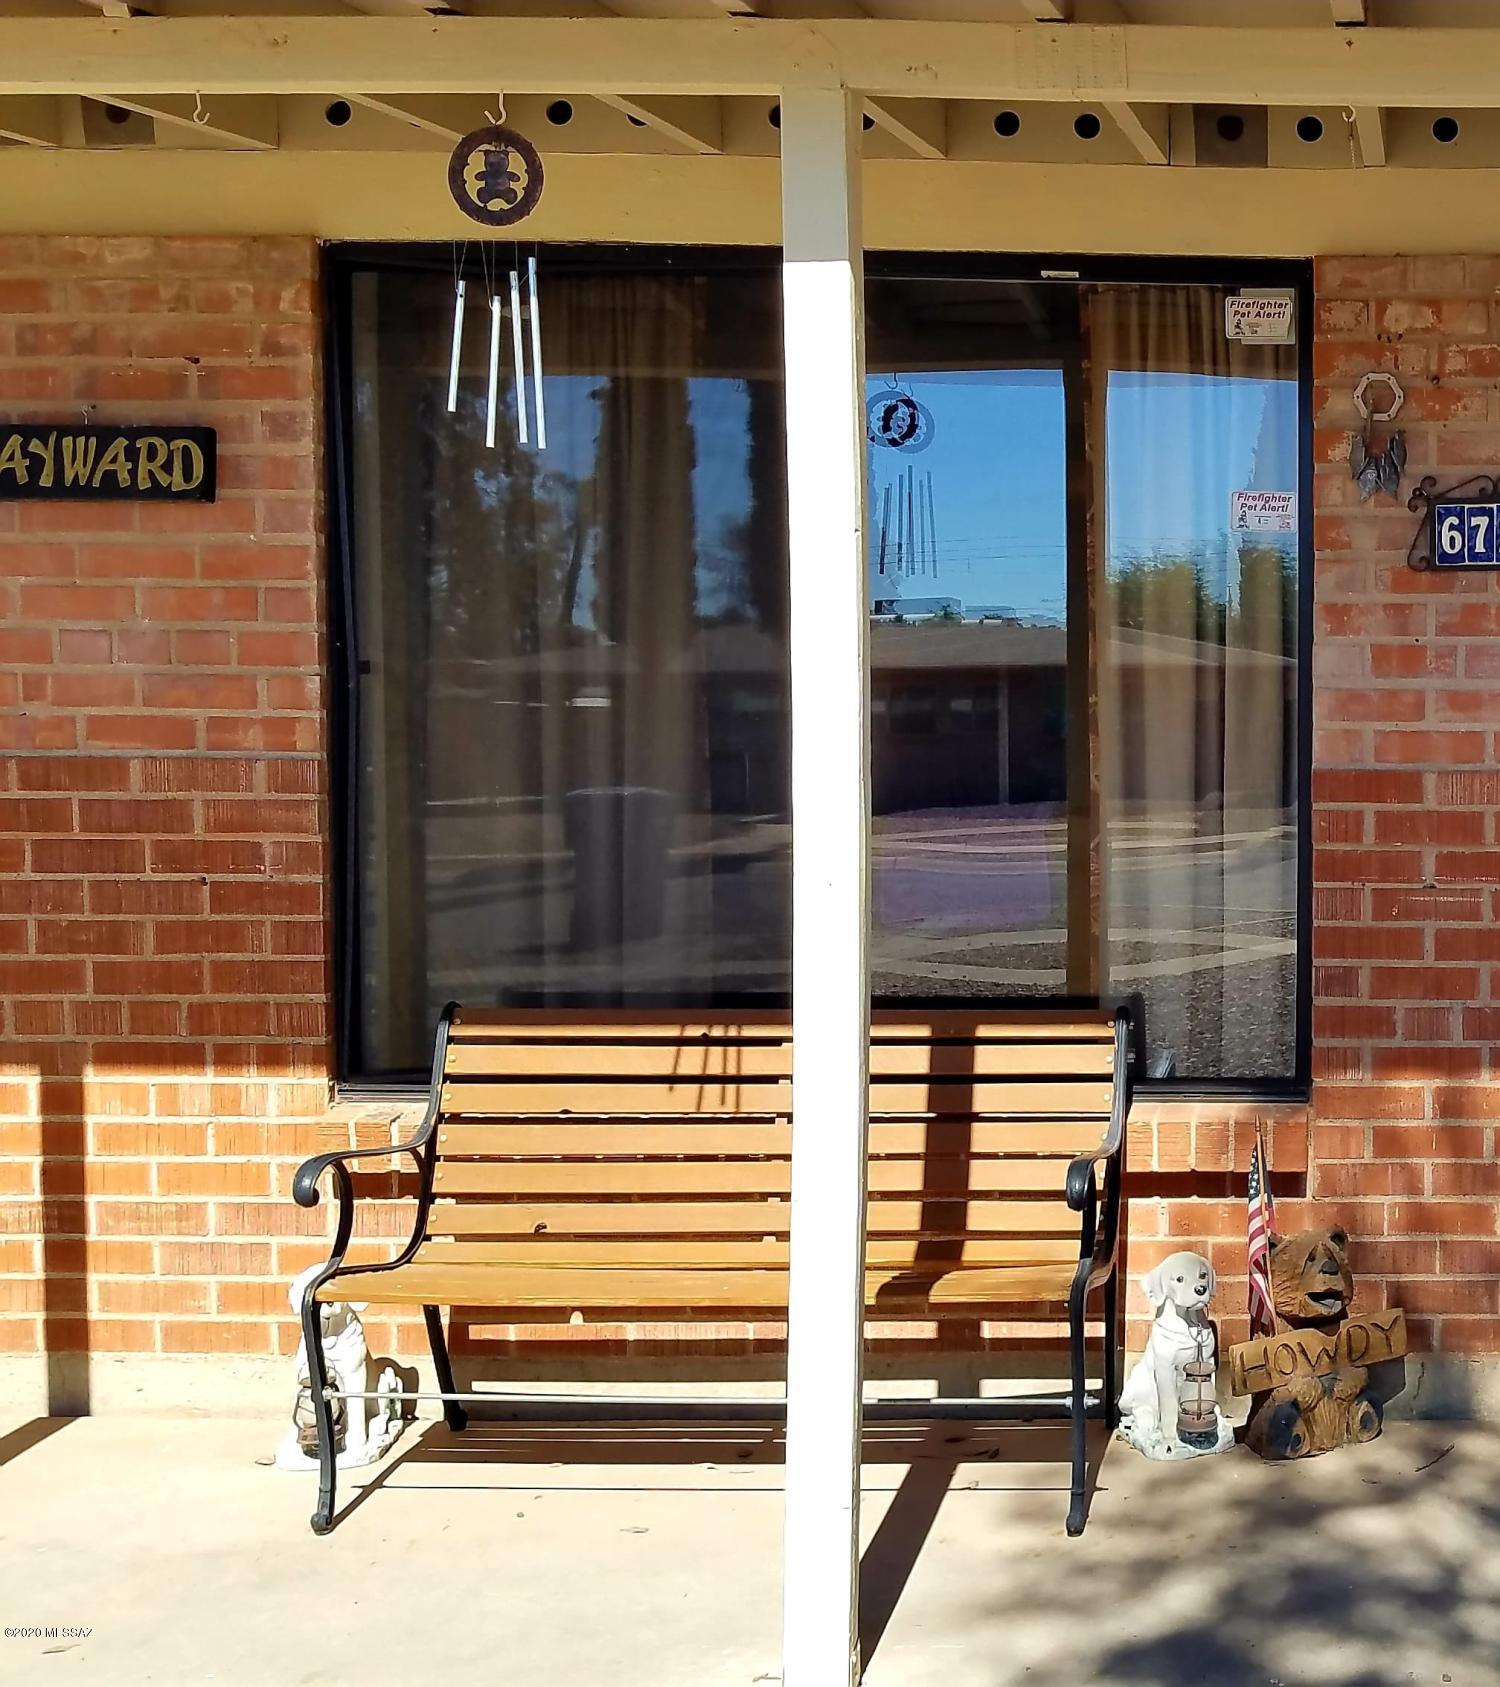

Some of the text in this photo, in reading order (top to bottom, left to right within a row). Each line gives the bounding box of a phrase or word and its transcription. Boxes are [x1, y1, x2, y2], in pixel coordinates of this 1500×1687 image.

[1229, 300, 1289, 311] Firefighter
[1233, 310, 1286, 319] Pet Alert!
[0, 431, 204, 492] AYWARD
[1237, 492, 1293, 504] Firefighter
[1240, 502, 1289, 513] Pet Alert!
[1239, 1314, 1401, 1390] HOWDY
